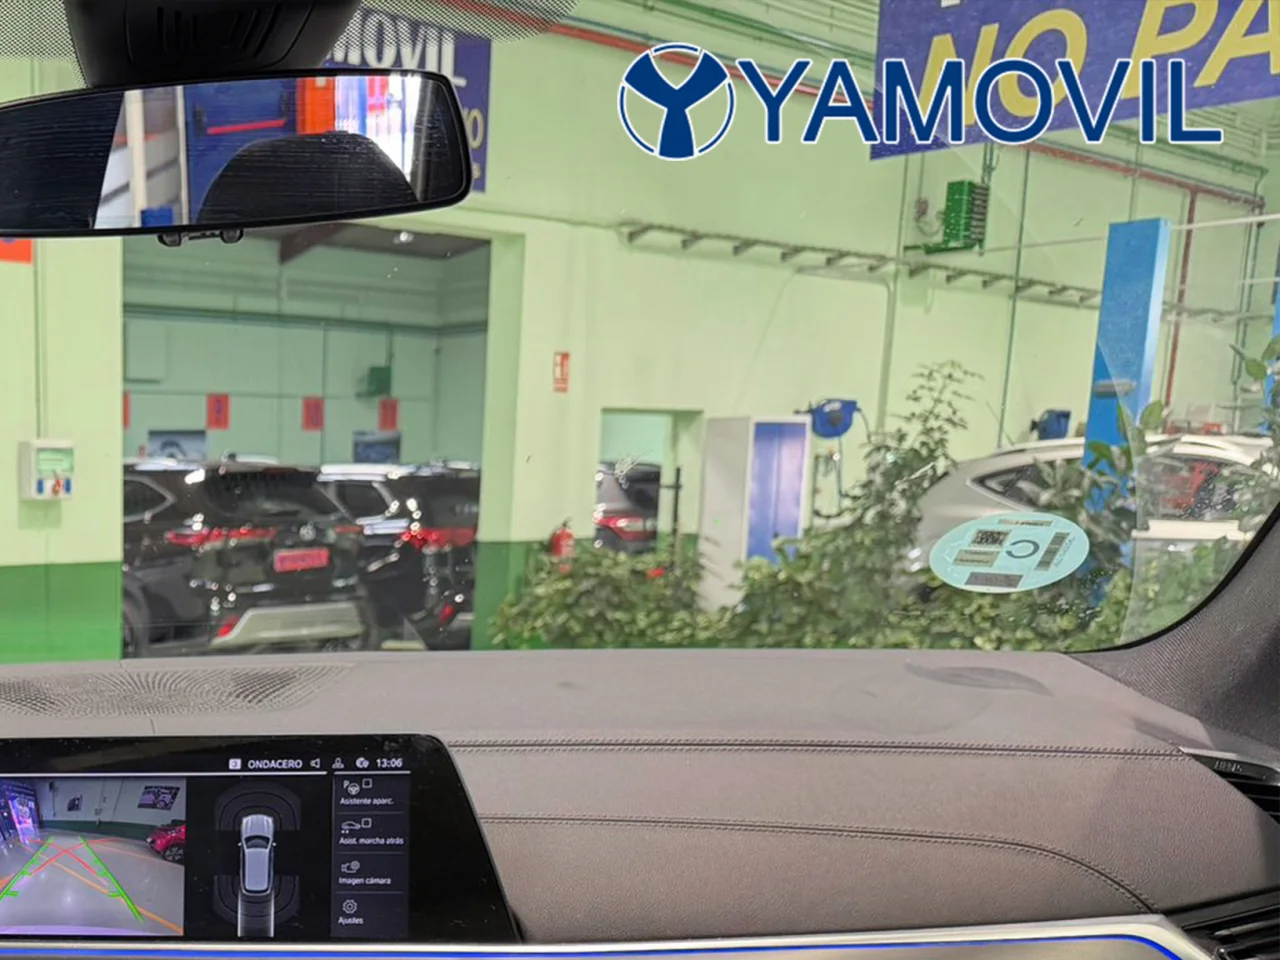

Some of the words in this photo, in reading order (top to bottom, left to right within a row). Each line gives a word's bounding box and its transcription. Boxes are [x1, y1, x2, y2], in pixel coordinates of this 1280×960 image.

[248, 759, 303, 769] ONDACERO
[376, 758, 403, 768] 13:06
[339, 797, 372, 805] Asistente
[372, 798, 395, 806] aparc.
[358, 837, 385, 845] marcha
[338, 877, 364, 886] Imagen
[338, 916, 364, 926] Ajustes
